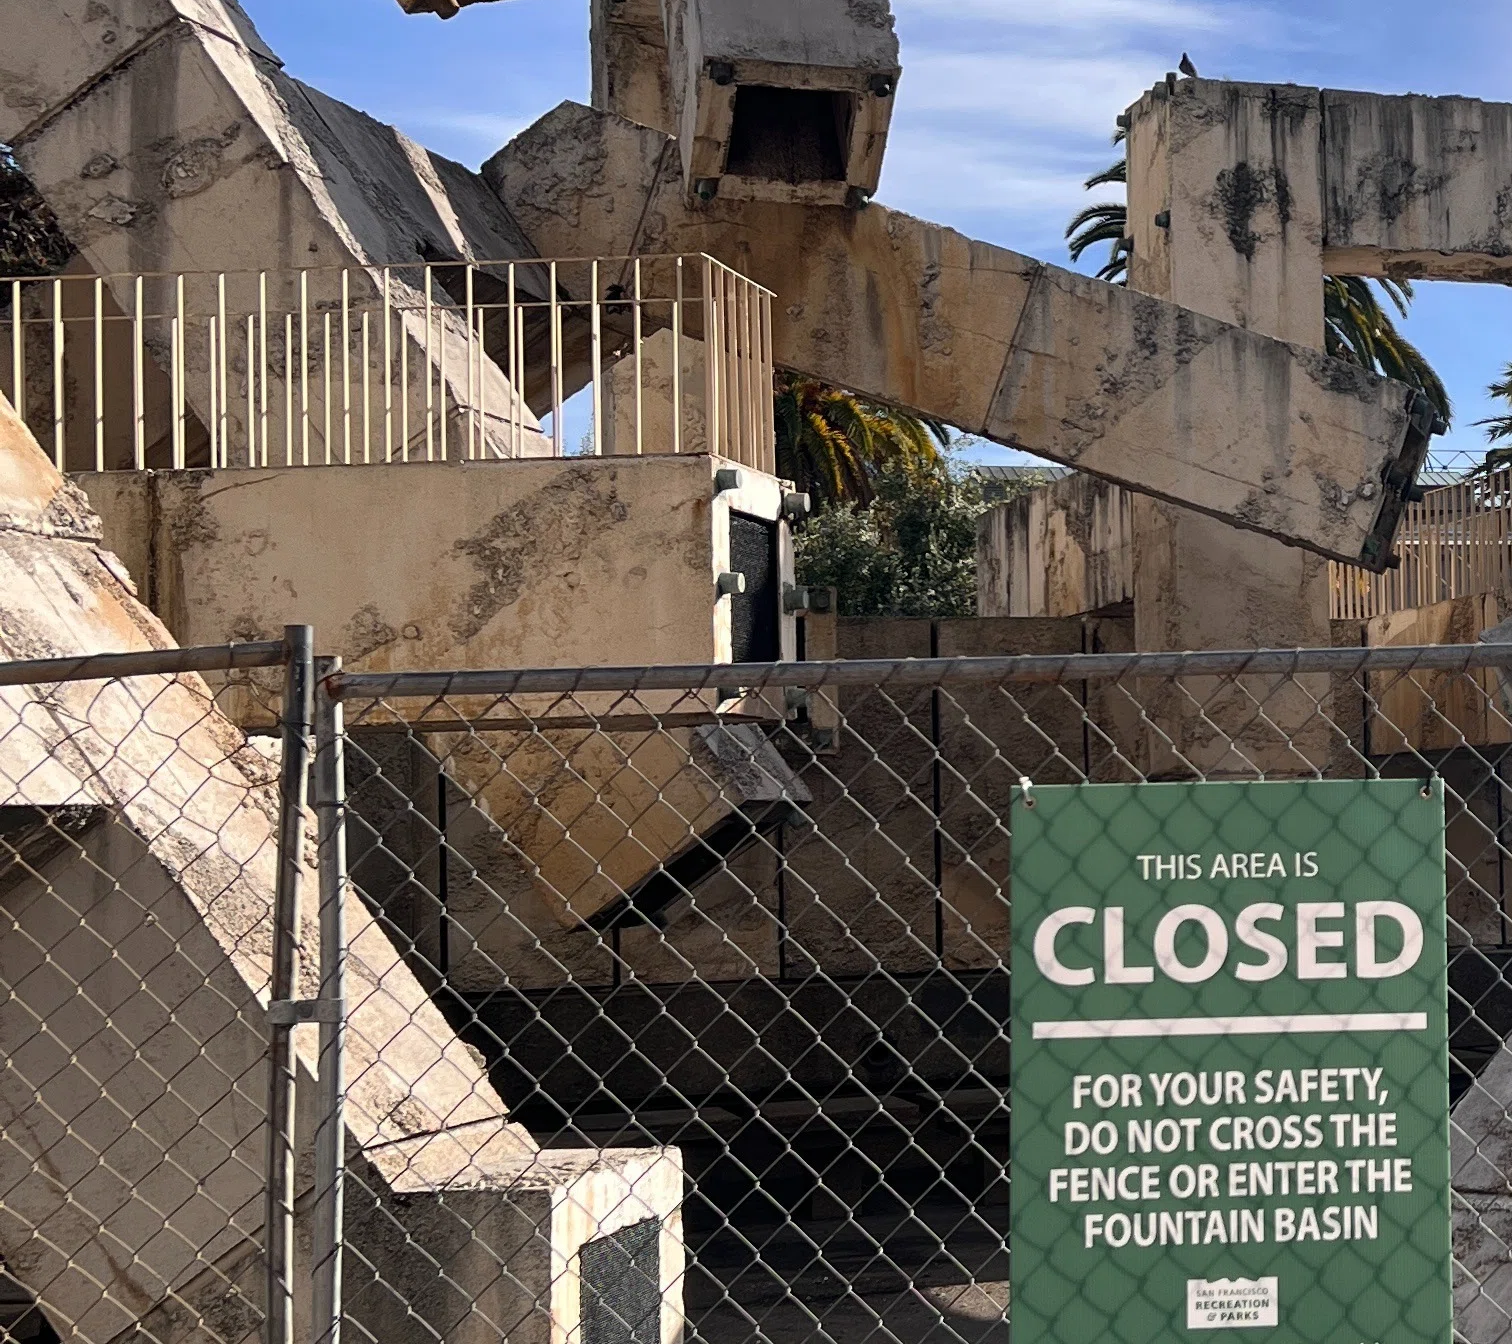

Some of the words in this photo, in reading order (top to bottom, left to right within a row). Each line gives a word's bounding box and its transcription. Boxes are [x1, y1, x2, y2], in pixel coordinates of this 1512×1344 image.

[1136, 853, 1203, 881] THIS
[1210, 852, 1287, 879] AREA
[1294, 852, 1319, 878] IS
[1033, 900, 1424, 986] CLOSED
[1073, 1074, 1142, 1109] FOR
[1149, 1071, 1246, 1106] YOUR
[1254, 1068, 1389, 1106] SAFETY,
[1065, 1120, 1122, 1156] DO
[1128, 1118, 1201, 1154] NOT
[1209, 1114, 1323, 1152] CROSS
[1331, 1113, 1397, 1148] THE
[1050, 1166, 1160, 1203] FENCE
[1168, 1163, 1219, 1199] OR
[1229, 1160, 1339, 1197] ENTER
[1345, 1159, 1413, 1194] THE
[1085, 1209, 1264, 1248] FOUNTAIN
[1275, 1206, 1378, 1242] BASIN
[1195, 1298, 1270, 1310] RECREATION
[1196, 1288, 1215, 1297] SAN
[1217, 1287, 1269, 1297] FRANCISCO
[1207, 1312, 1217, 1322] &
[1220, 1310, 1259, 1321] PARKS
